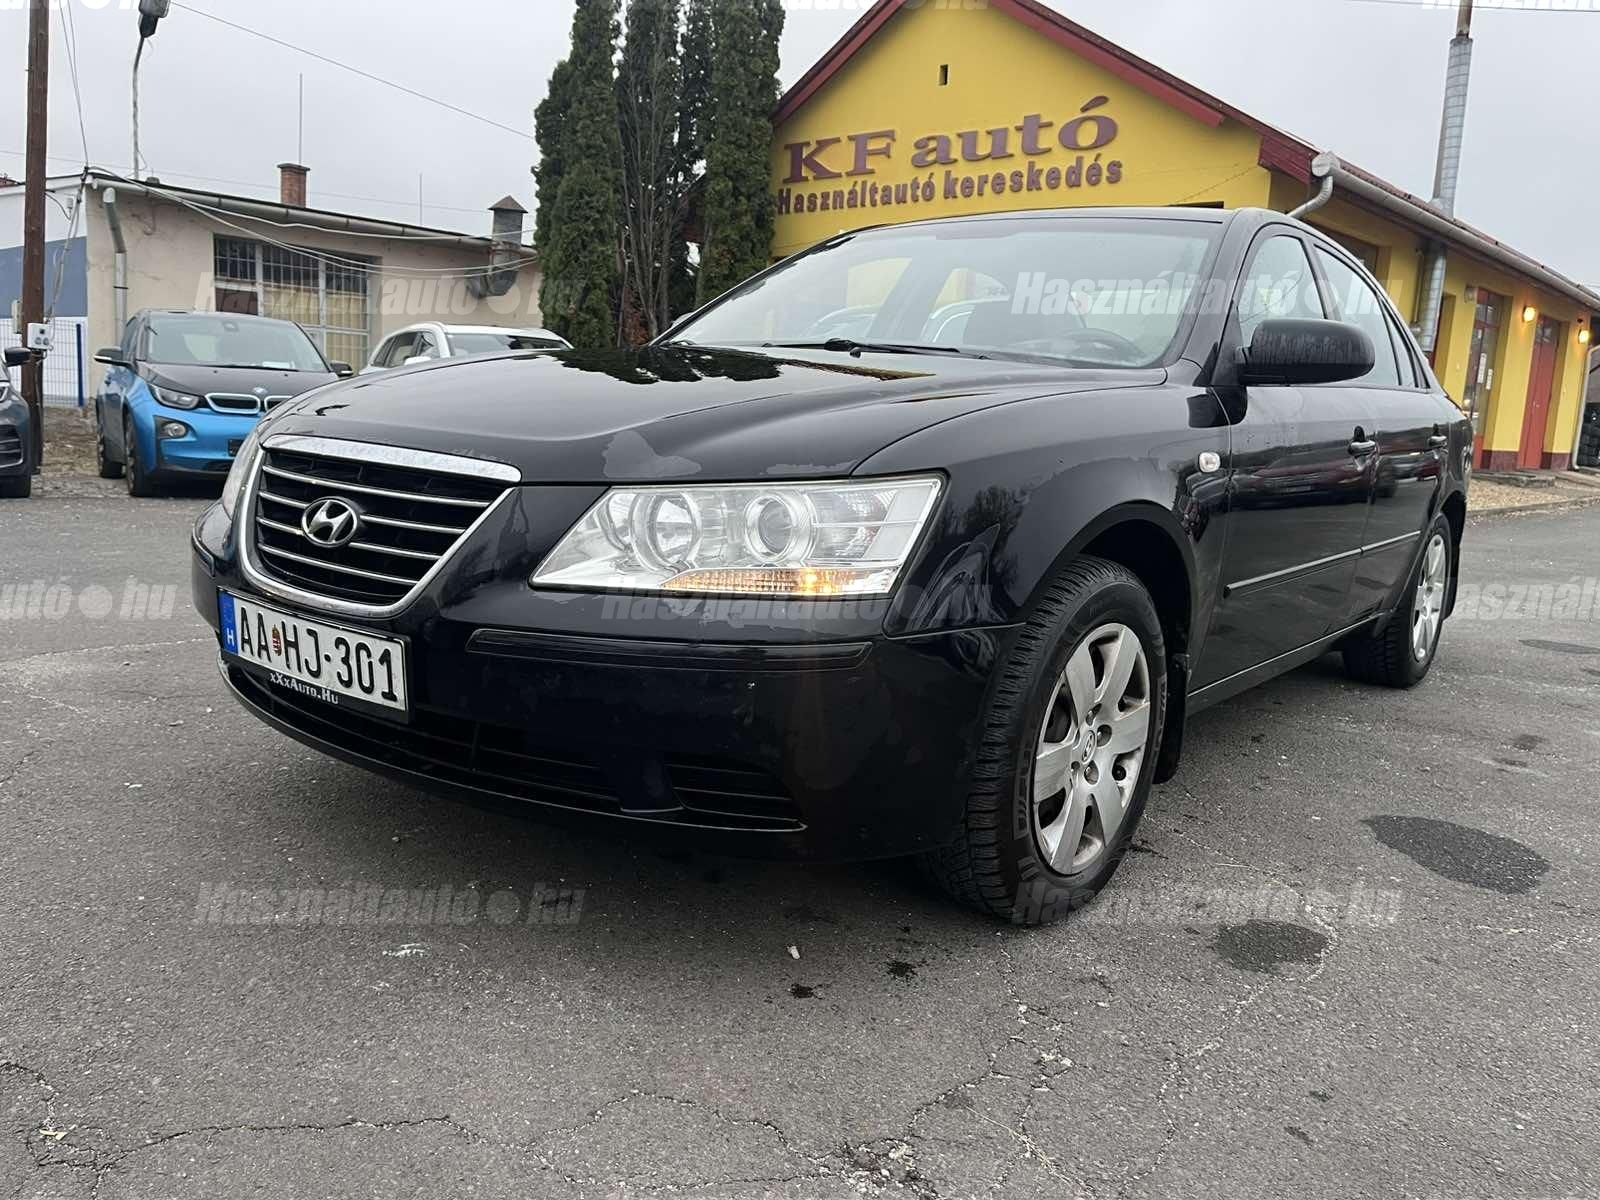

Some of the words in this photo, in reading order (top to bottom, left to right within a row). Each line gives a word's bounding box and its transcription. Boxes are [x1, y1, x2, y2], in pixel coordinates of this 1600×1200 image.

[783, 129, 896, 184] KF
[911, 95, 1118, 168] autó
[777, 172, 935, 215] Használtautó
[943, 153, 1123, 200] kereskedés
